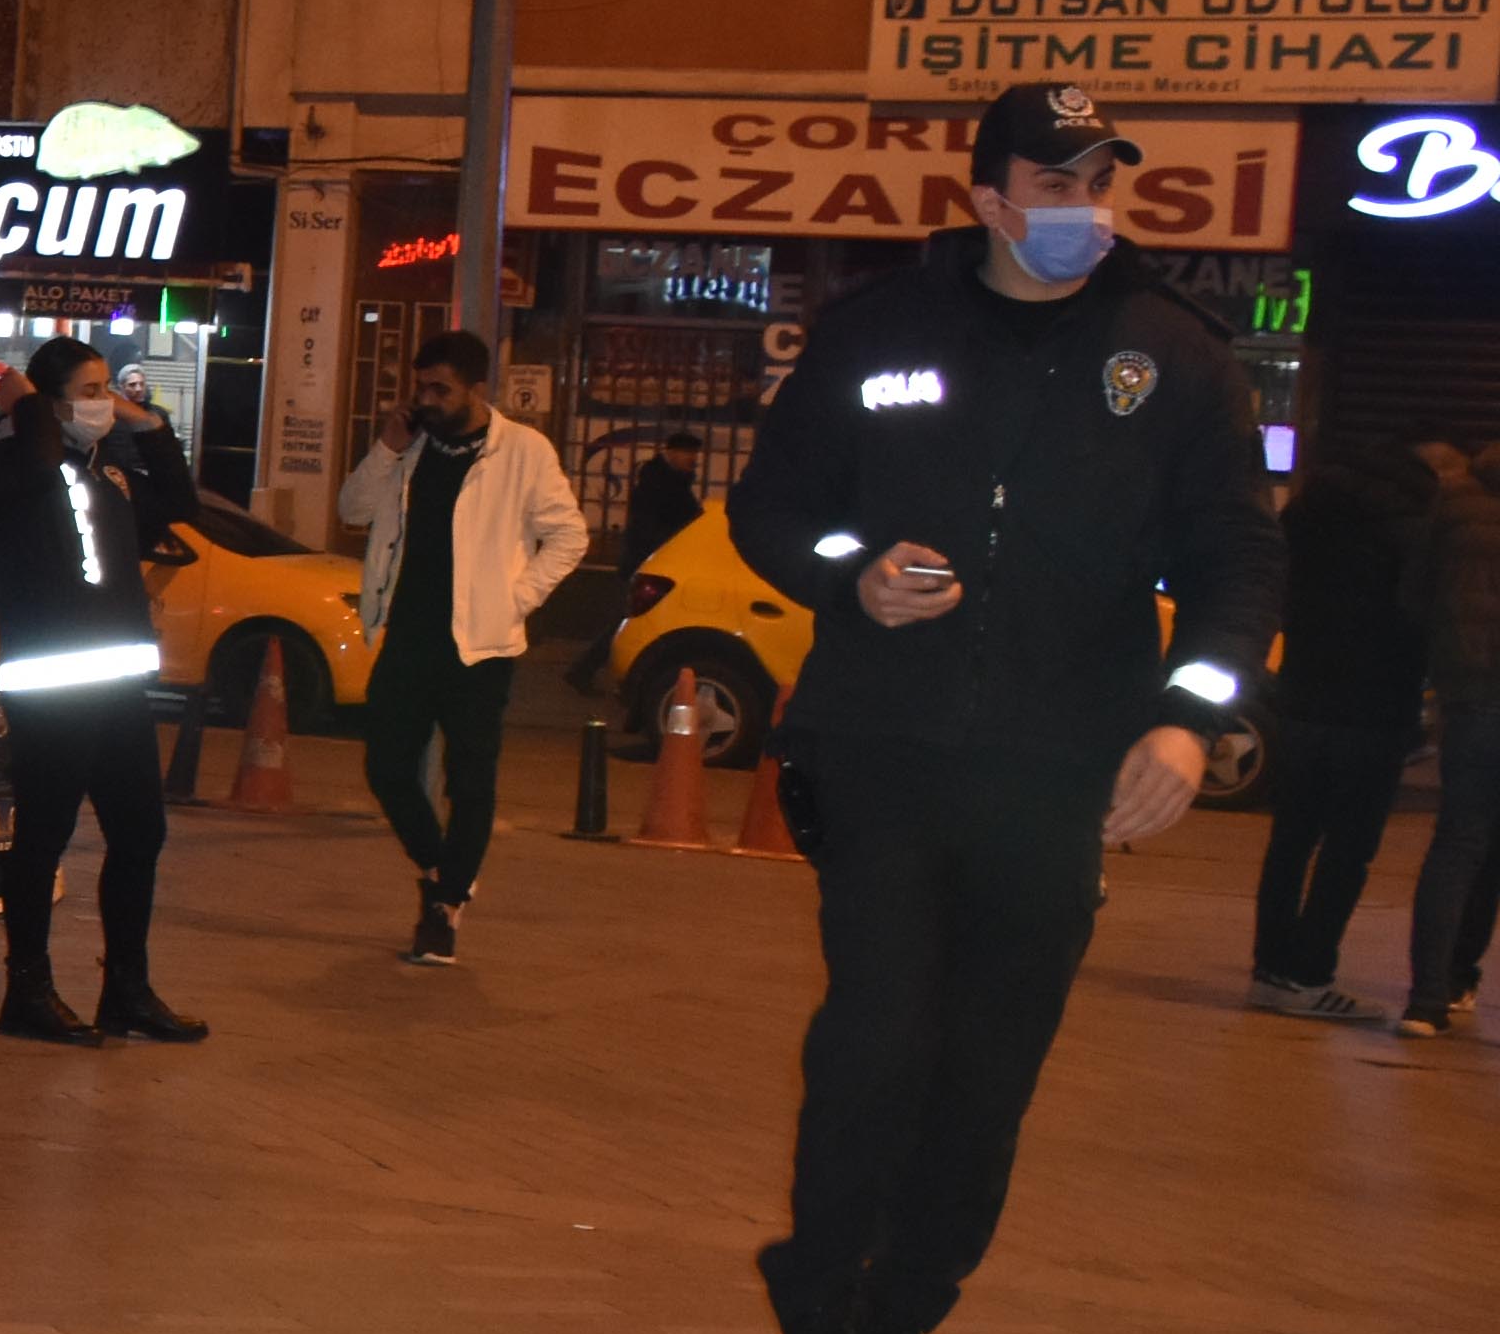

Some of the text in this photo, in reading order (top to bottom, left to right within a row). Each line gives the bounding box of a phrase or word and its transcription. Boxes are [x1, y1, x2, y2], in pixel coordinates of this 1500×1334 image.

[896, 25, 1462, 76] İŞİTME CİHAZI
[1153, 77, 1242, 94] Merkezi
[711, 114, 981, 156] ÇORL
[527, 146, 1268, 237] ECZANSİ
[69, 286, 133, 305] PAKET
